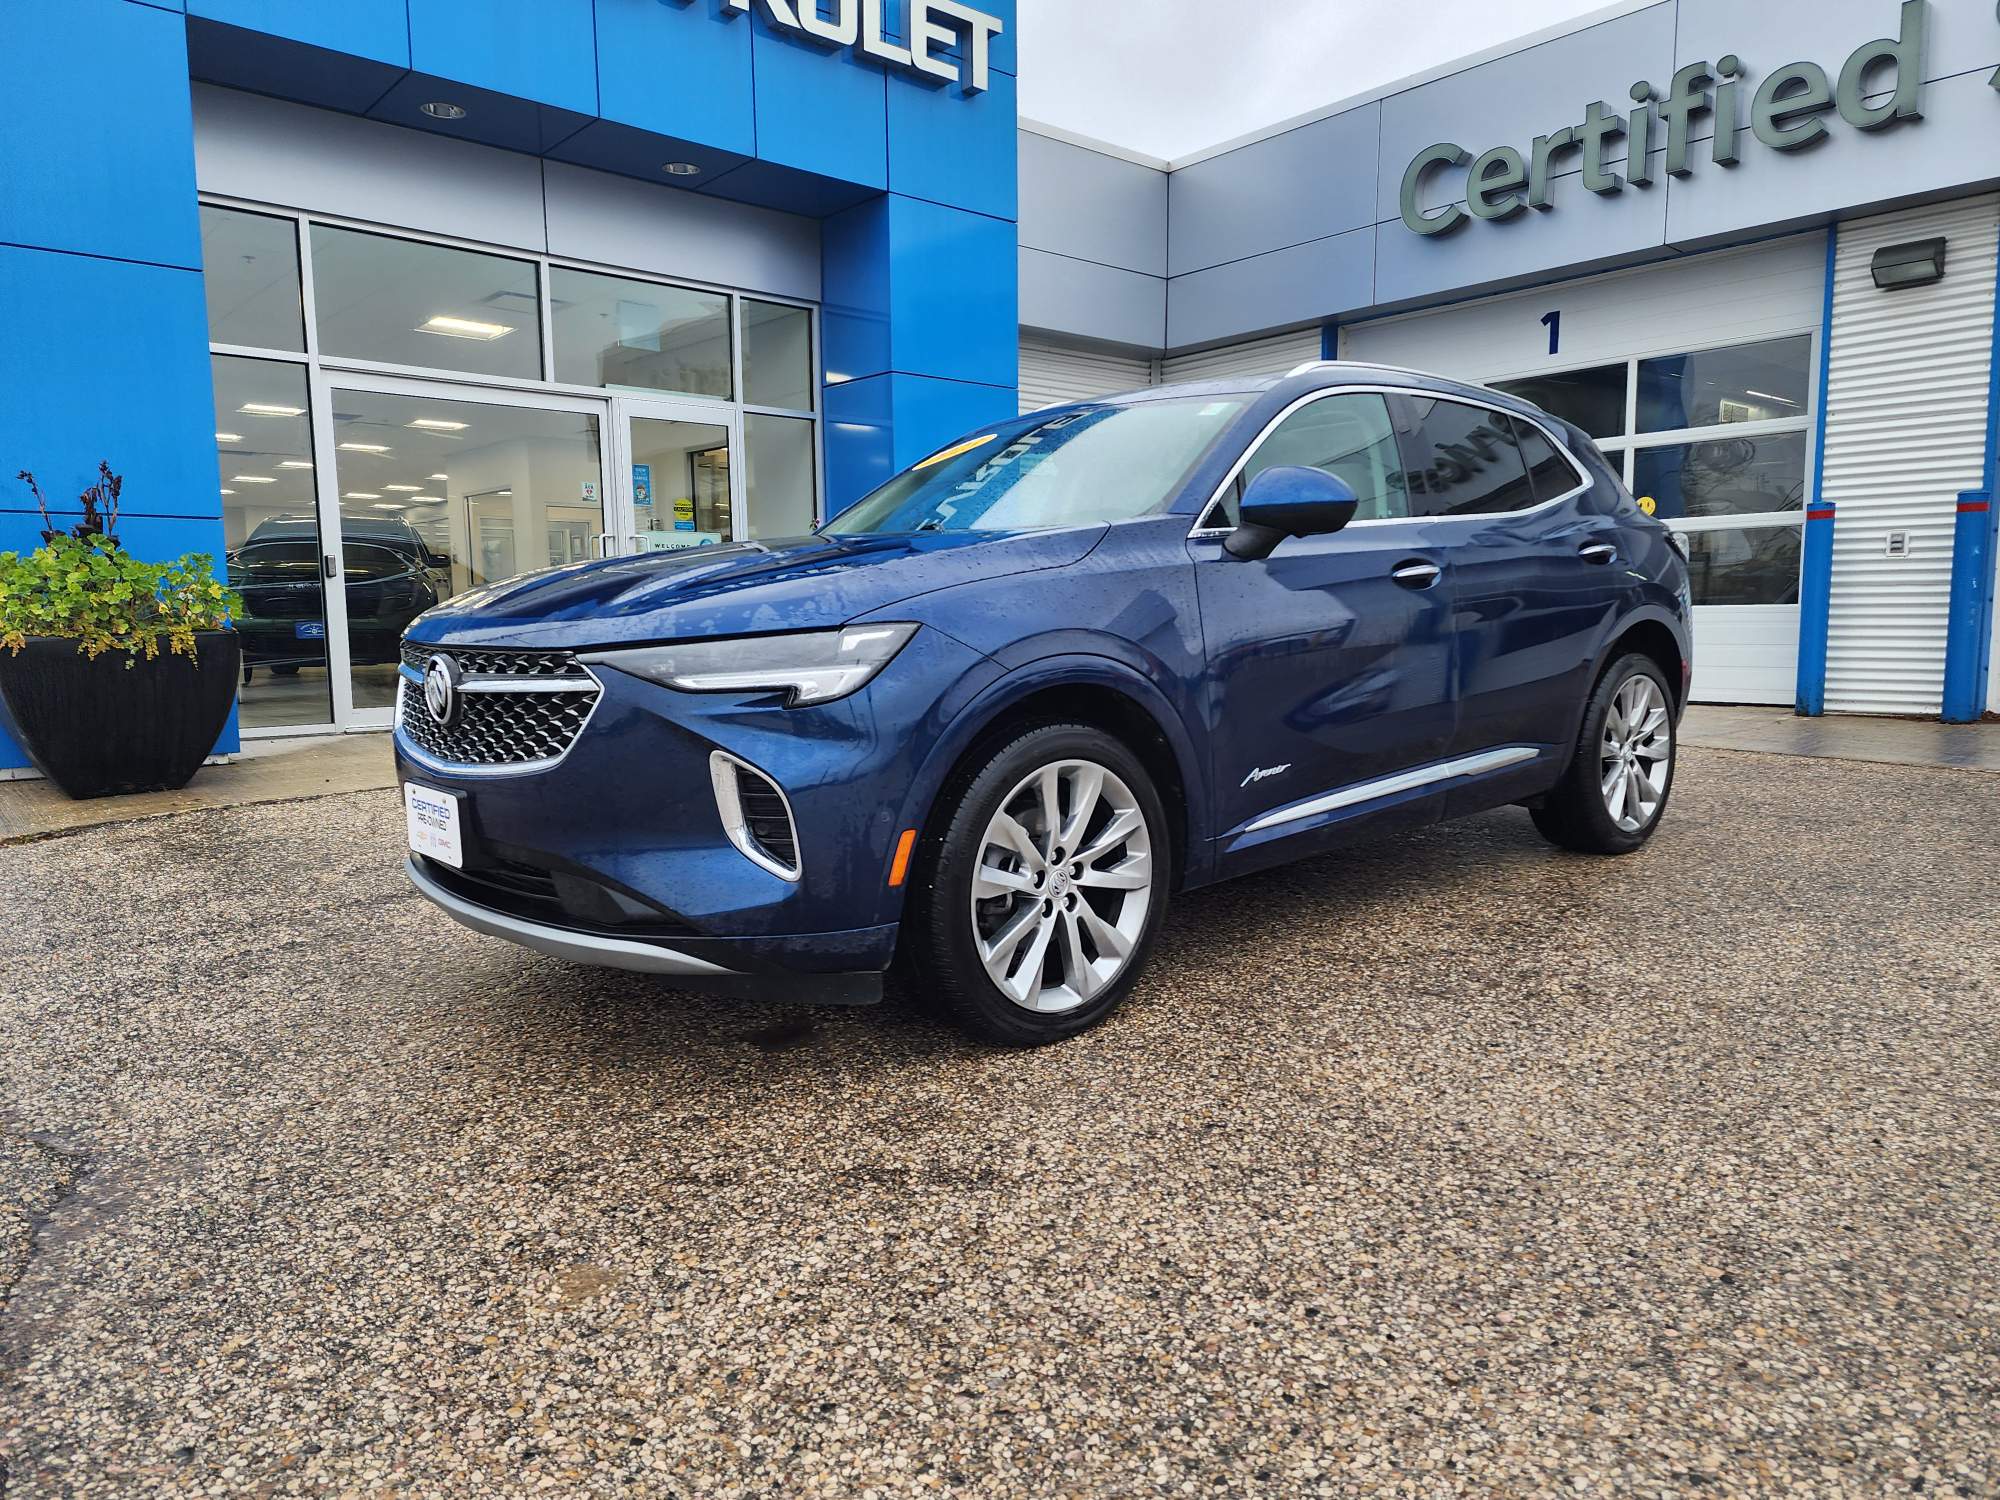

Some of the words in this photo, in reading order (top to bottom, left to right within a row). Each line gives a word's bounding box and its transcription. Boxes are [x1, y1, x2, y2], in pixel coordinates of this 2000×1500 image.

[1400, 0, 1930, 236] Certified
[1540, 310, 1561, 355] 1
[412, 798, 451, 819] CERTIFIED
[418, 813, 447, 831] PRE-OWNED
